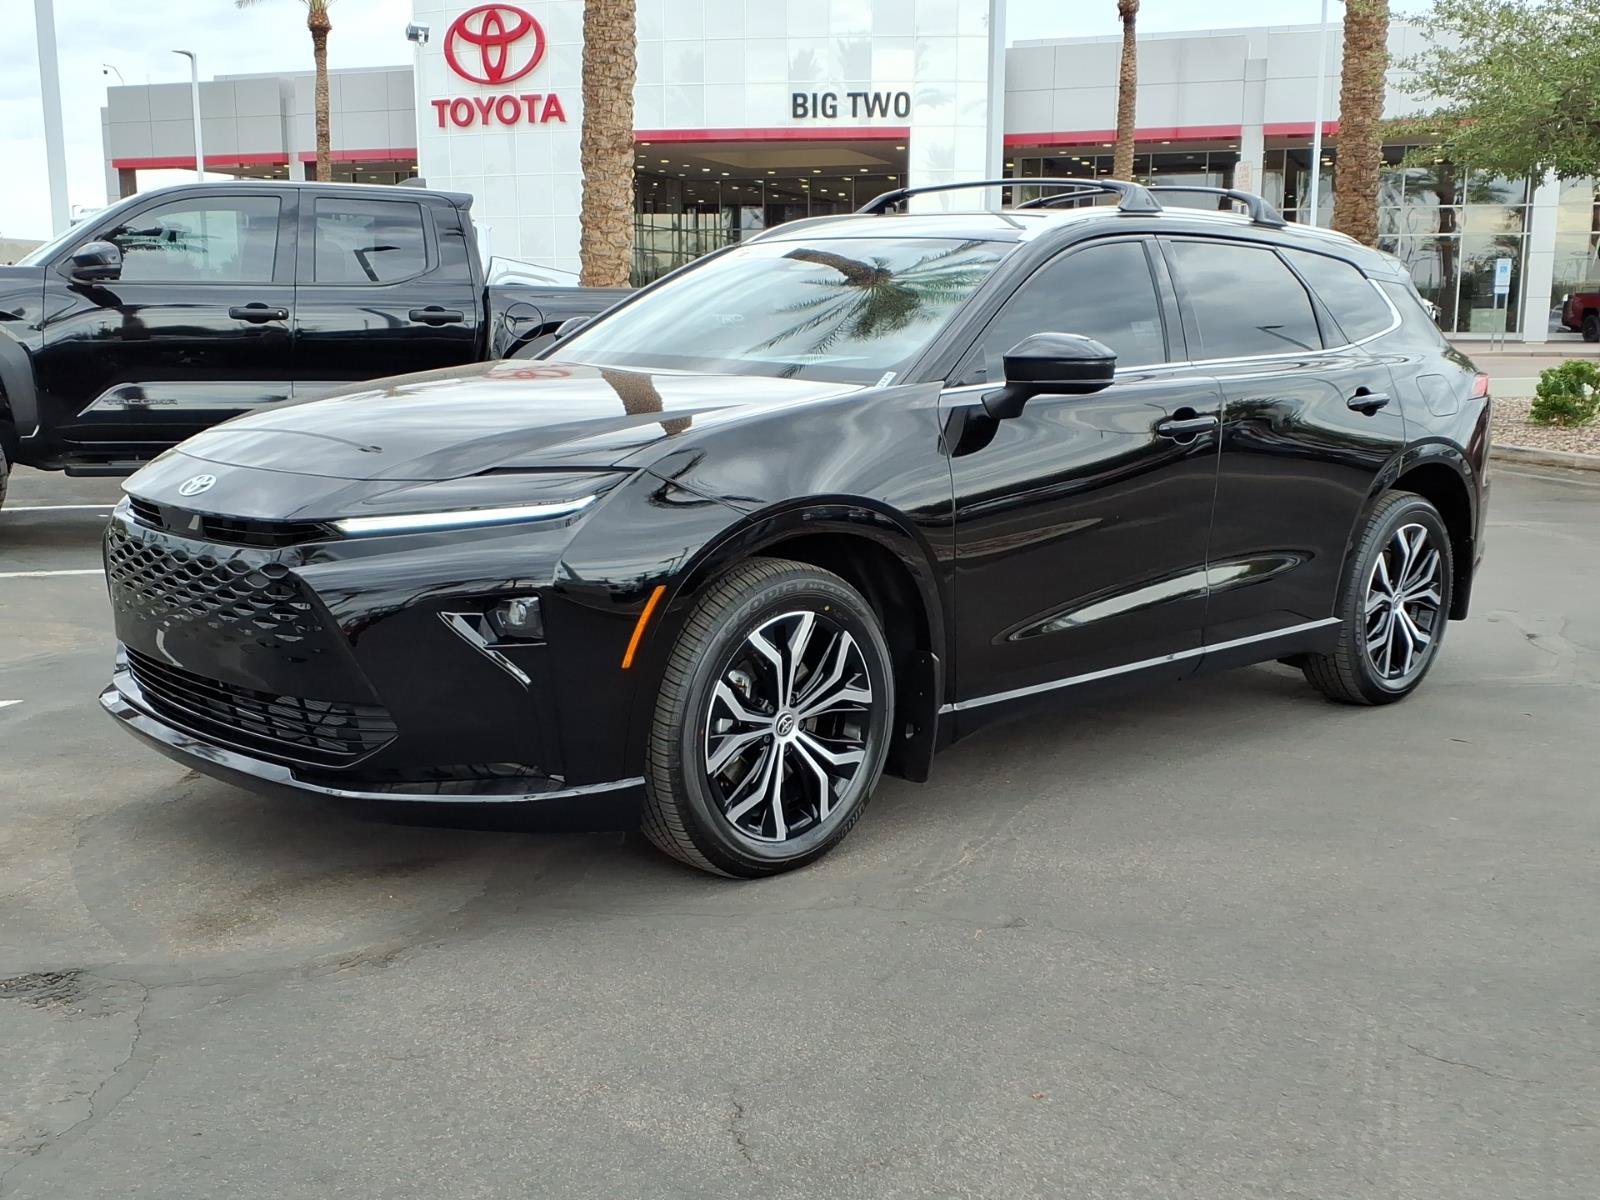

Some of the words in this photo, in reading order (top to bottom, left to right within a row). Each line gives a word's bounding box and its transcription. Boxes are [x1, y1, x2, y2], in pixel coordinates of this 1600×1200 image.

[431, 93, 567, 128] TOYOTA
[792, 92, 838, 119] BIG
[846, 91, 911, 118] TWO
